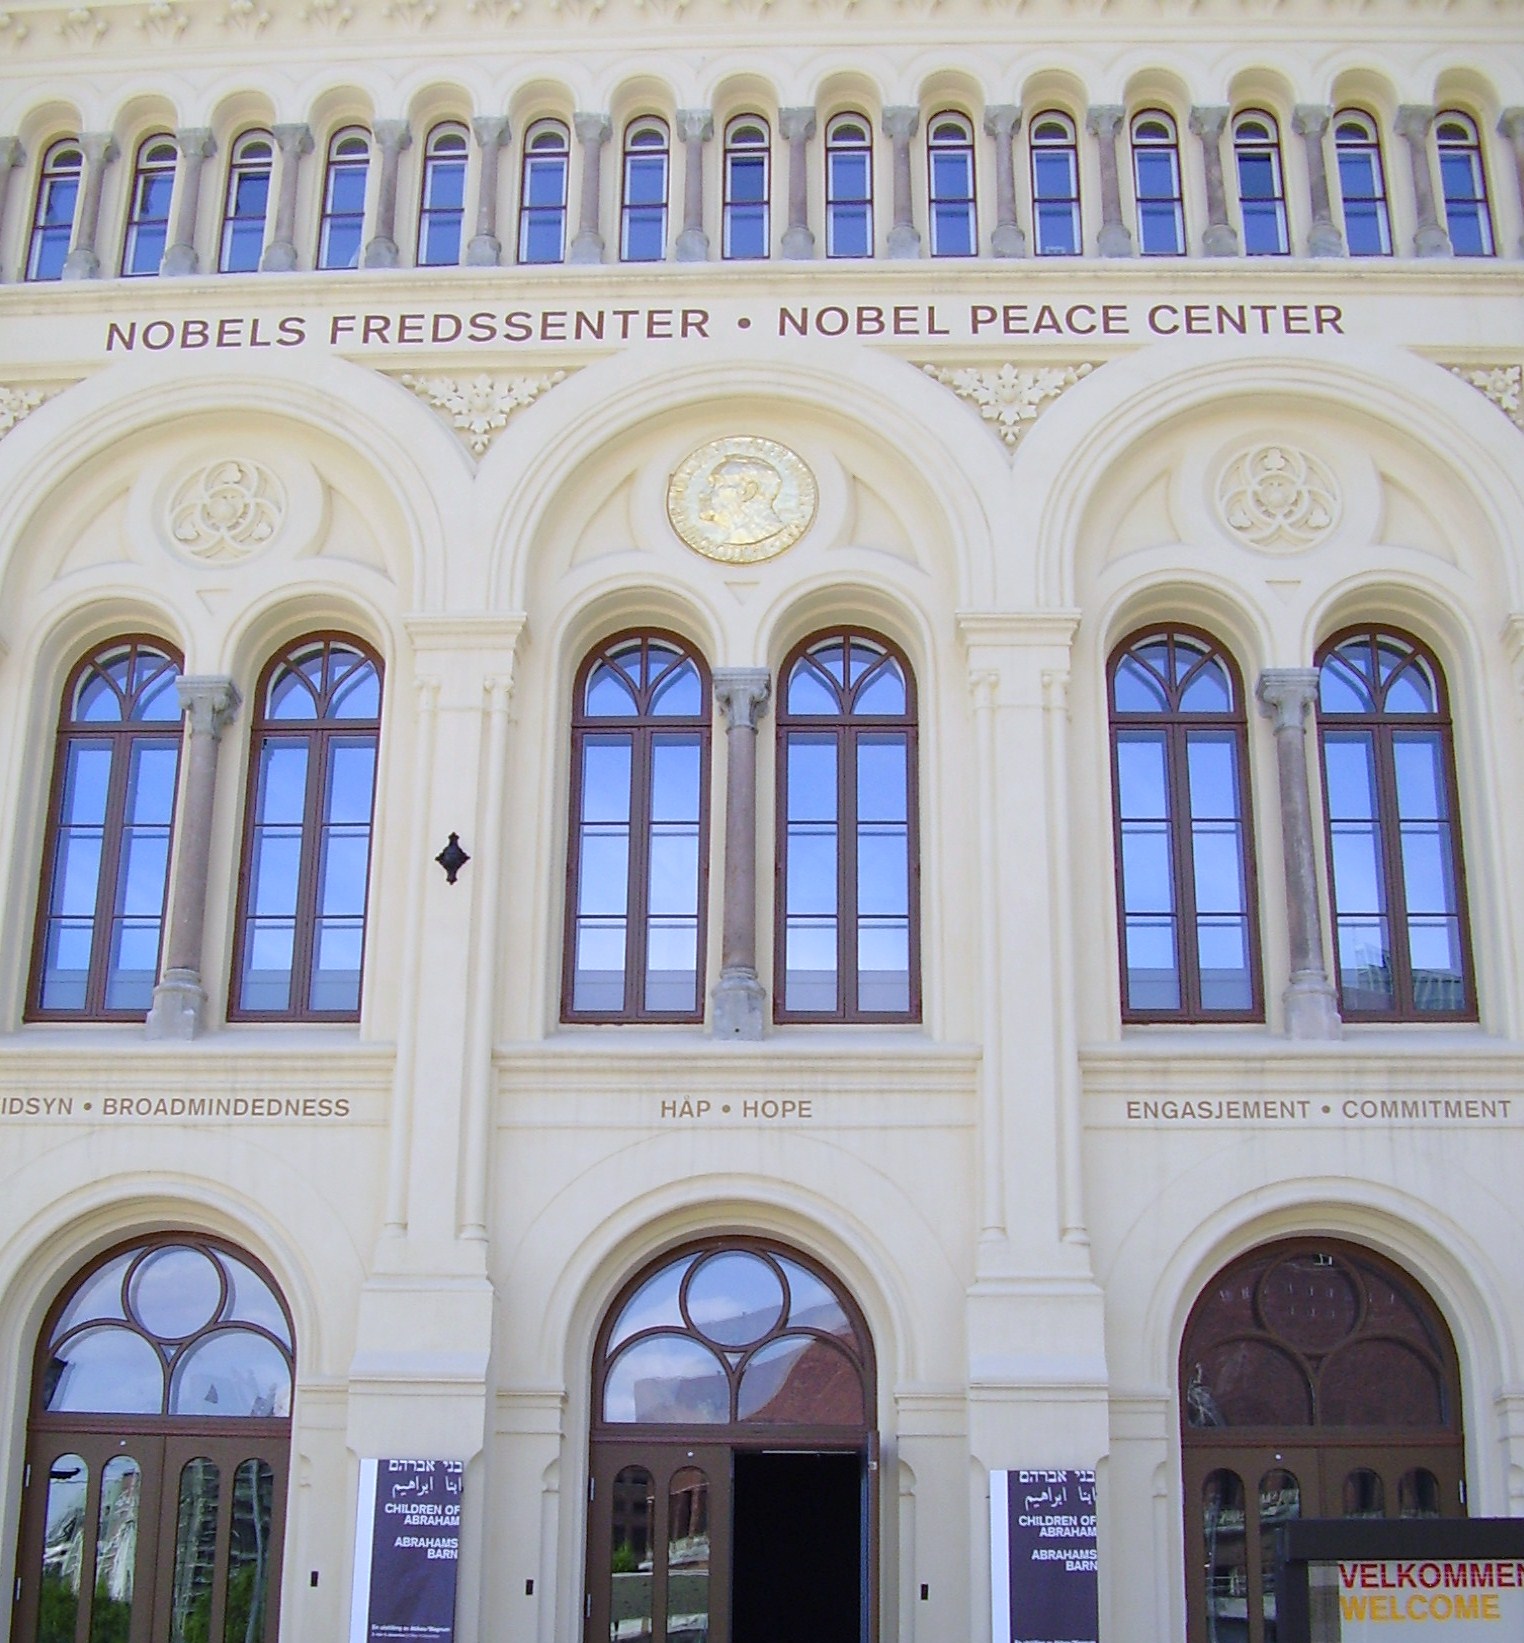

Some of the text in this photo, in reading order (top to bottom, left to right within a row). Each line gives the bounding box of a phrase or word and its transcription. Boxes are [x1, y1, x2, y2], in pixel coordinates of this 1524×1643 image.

[107, 304, 1345, 351] NOBELS FREDSSENTER NOBEL PEACE CENTER
[0, 1097, 350, 1117] IDSYN BROADMINDEDNESS
[661, 1095, 813, 1118] HÅP HOPE
[1126, 1100, 1512, 1119] ENGASJEMENT COMMITMENT
[384, 1503, 460, 1515] CHILDREN OF
[404, 1514, 460, 1526] ABRAHAM
[1018, 1515, 1097, 1527] CHILDREN OF
[1039, 1526, 1098, 1538] ABRAHAM
[394, 1536, 459, 1549] ABRAHAMS
[427, 1548, 458, 1559] BARN
[1031, 1549, 1098, 1561] ABRAHAMS
[1065, 1560, 1098, 1571] BARN
[1339, 1593, 1502, 1623] WELCOME
